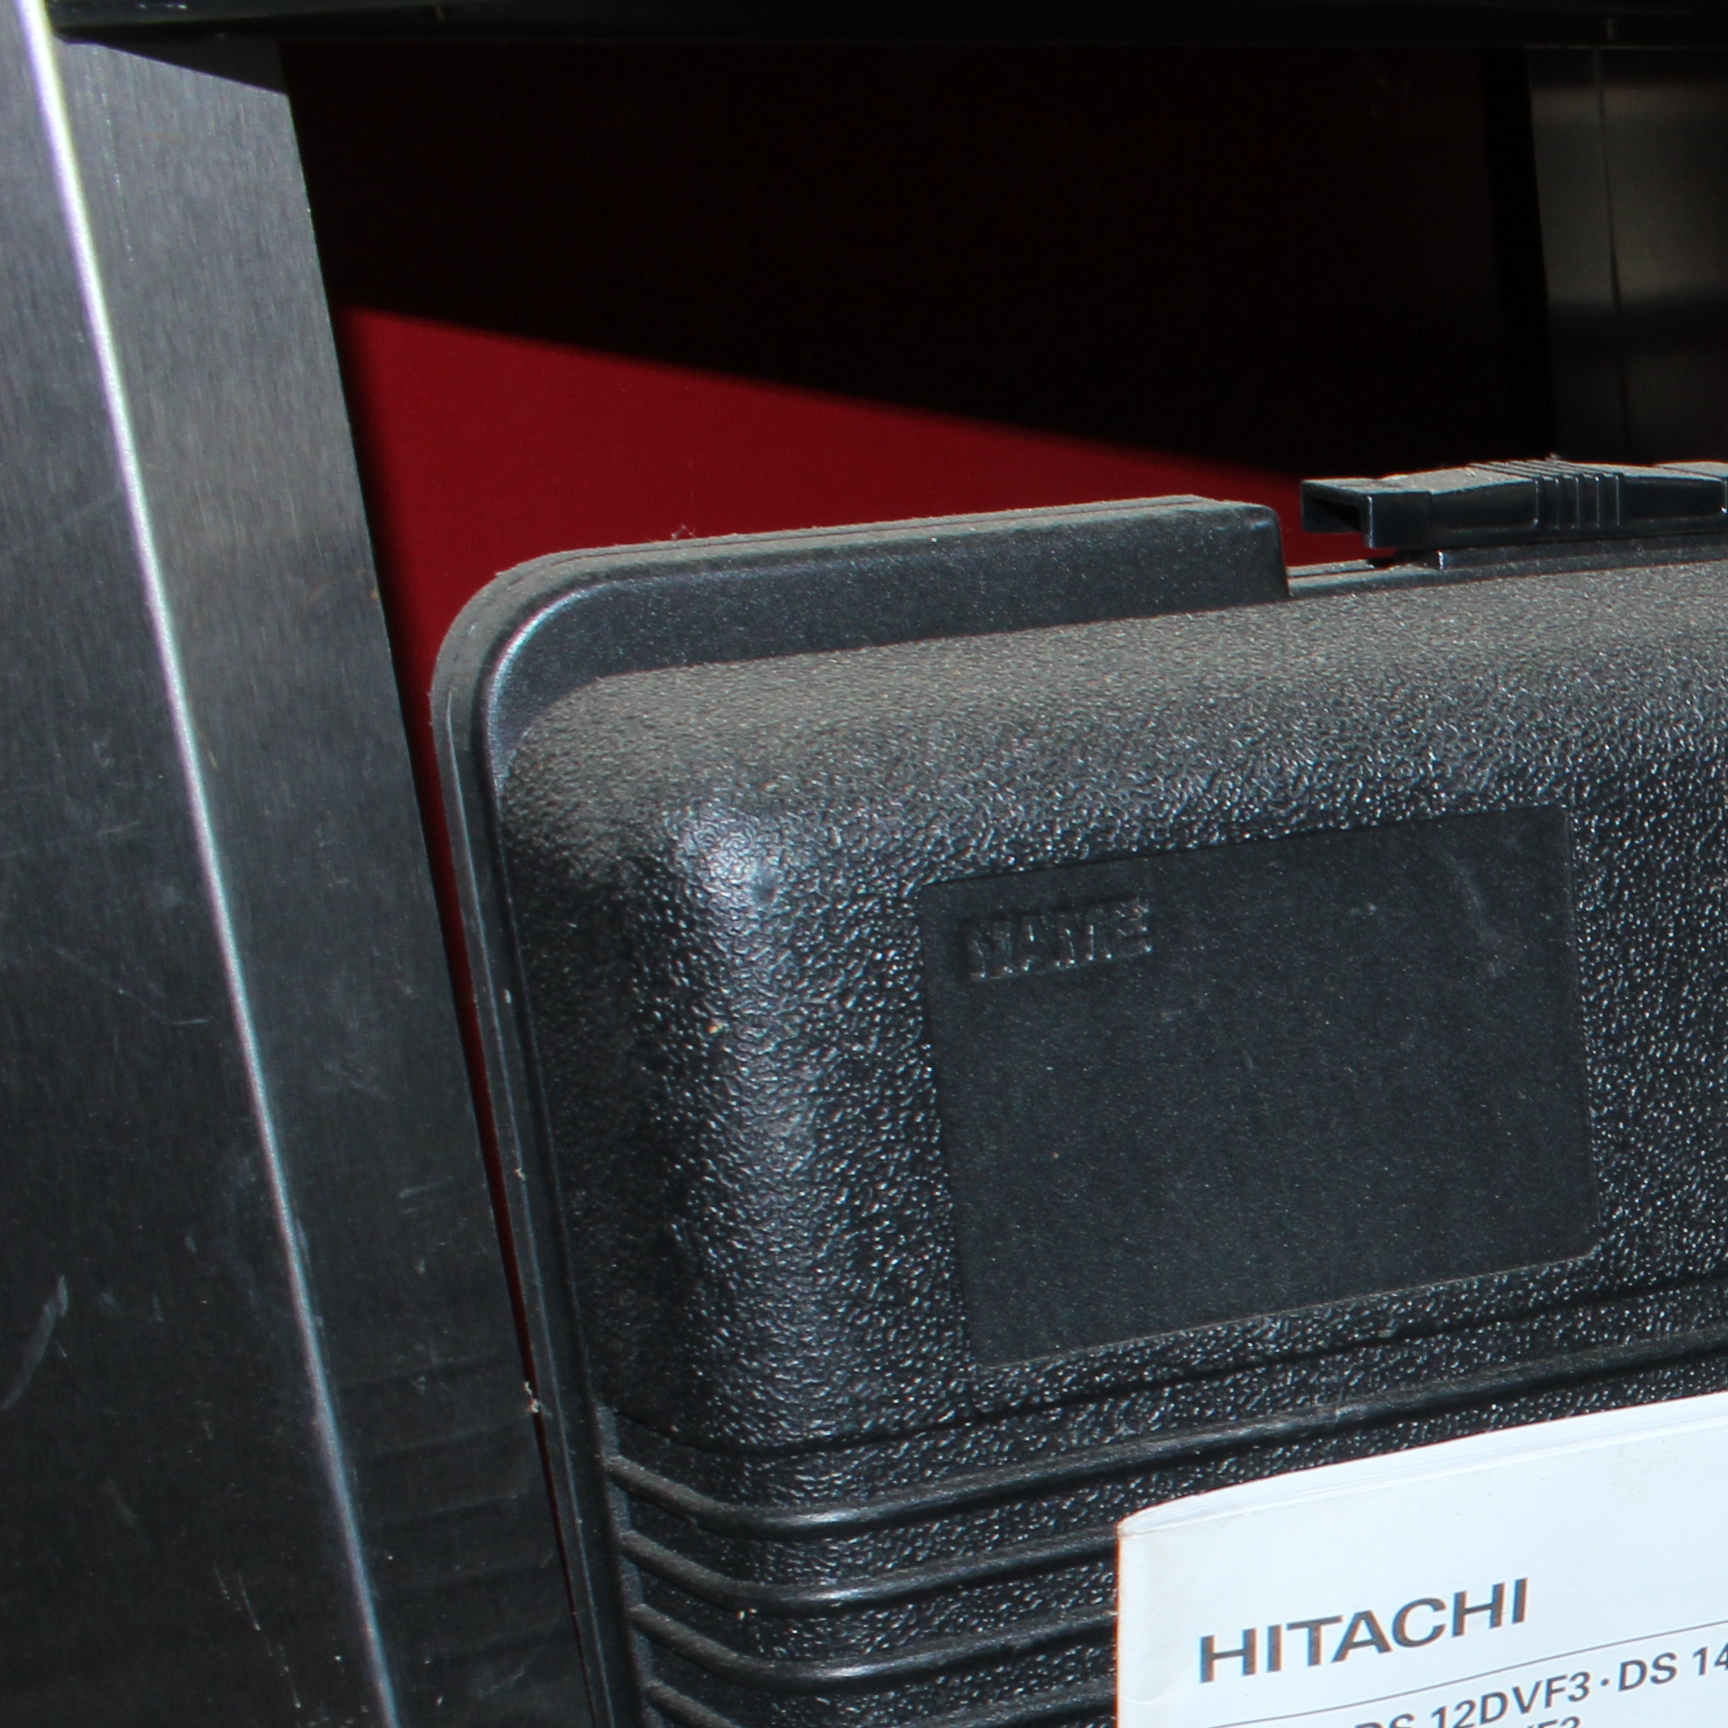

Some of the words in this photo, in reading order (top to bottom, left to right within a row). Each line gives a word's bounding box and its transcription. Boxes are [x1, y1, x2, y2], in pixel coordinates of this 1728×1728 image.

[966, 893, 1153, 980] NAME
[1200, 1576, 1529, 1684] HITACHI
[1617, 1652, 1678, 1692] DS
